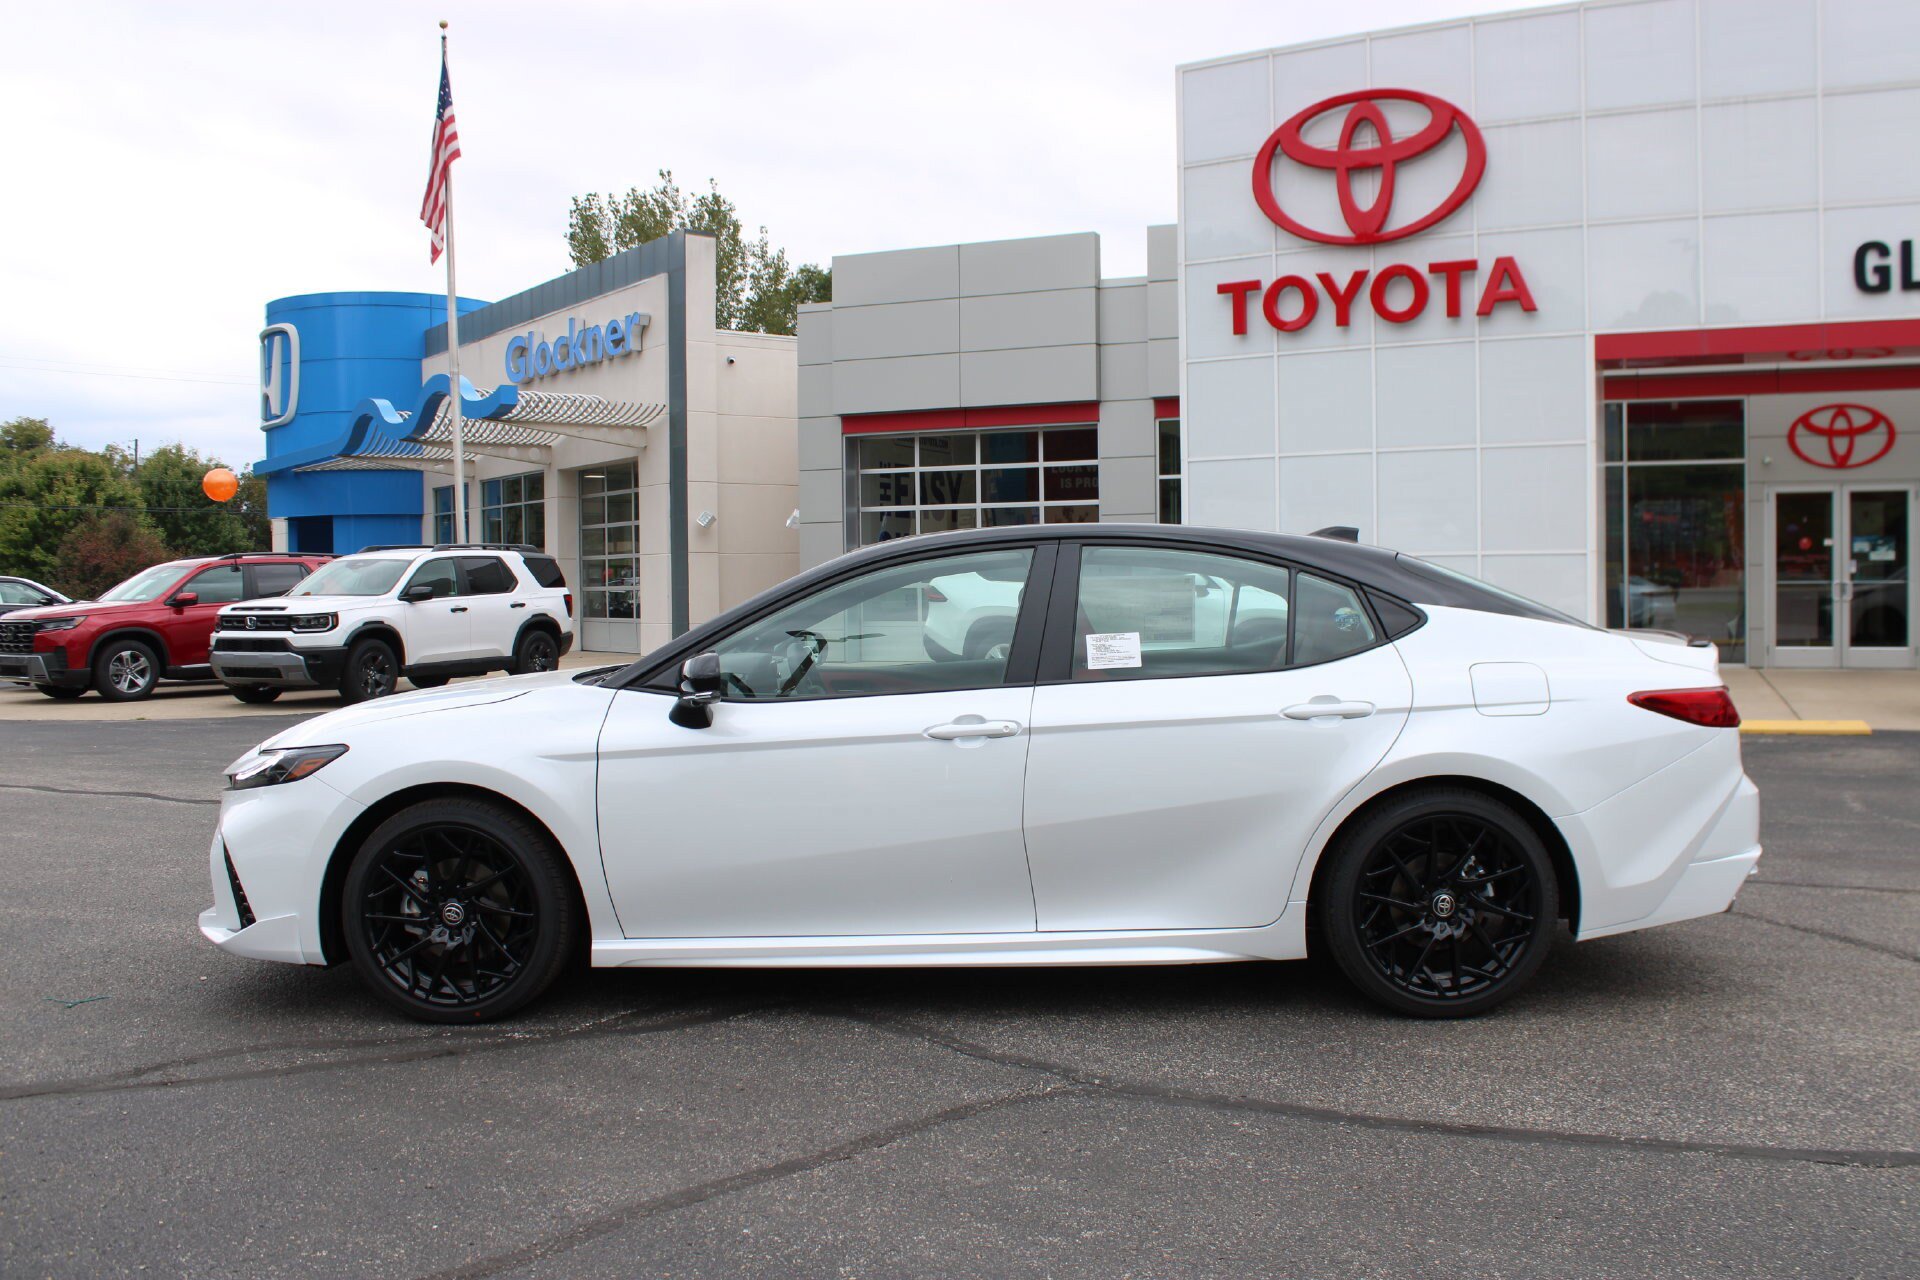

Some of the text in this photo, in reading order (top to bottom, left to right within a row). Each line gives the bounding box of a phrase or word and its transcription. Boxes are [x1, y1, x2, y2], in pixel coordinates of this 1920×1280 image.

[1217, 257, 1538, 335] TOYOTA
[505, 311, 649, 383] Glockner
[895, 463, 963, 523] EASY
[1060, 477, 1072, 489] IS
